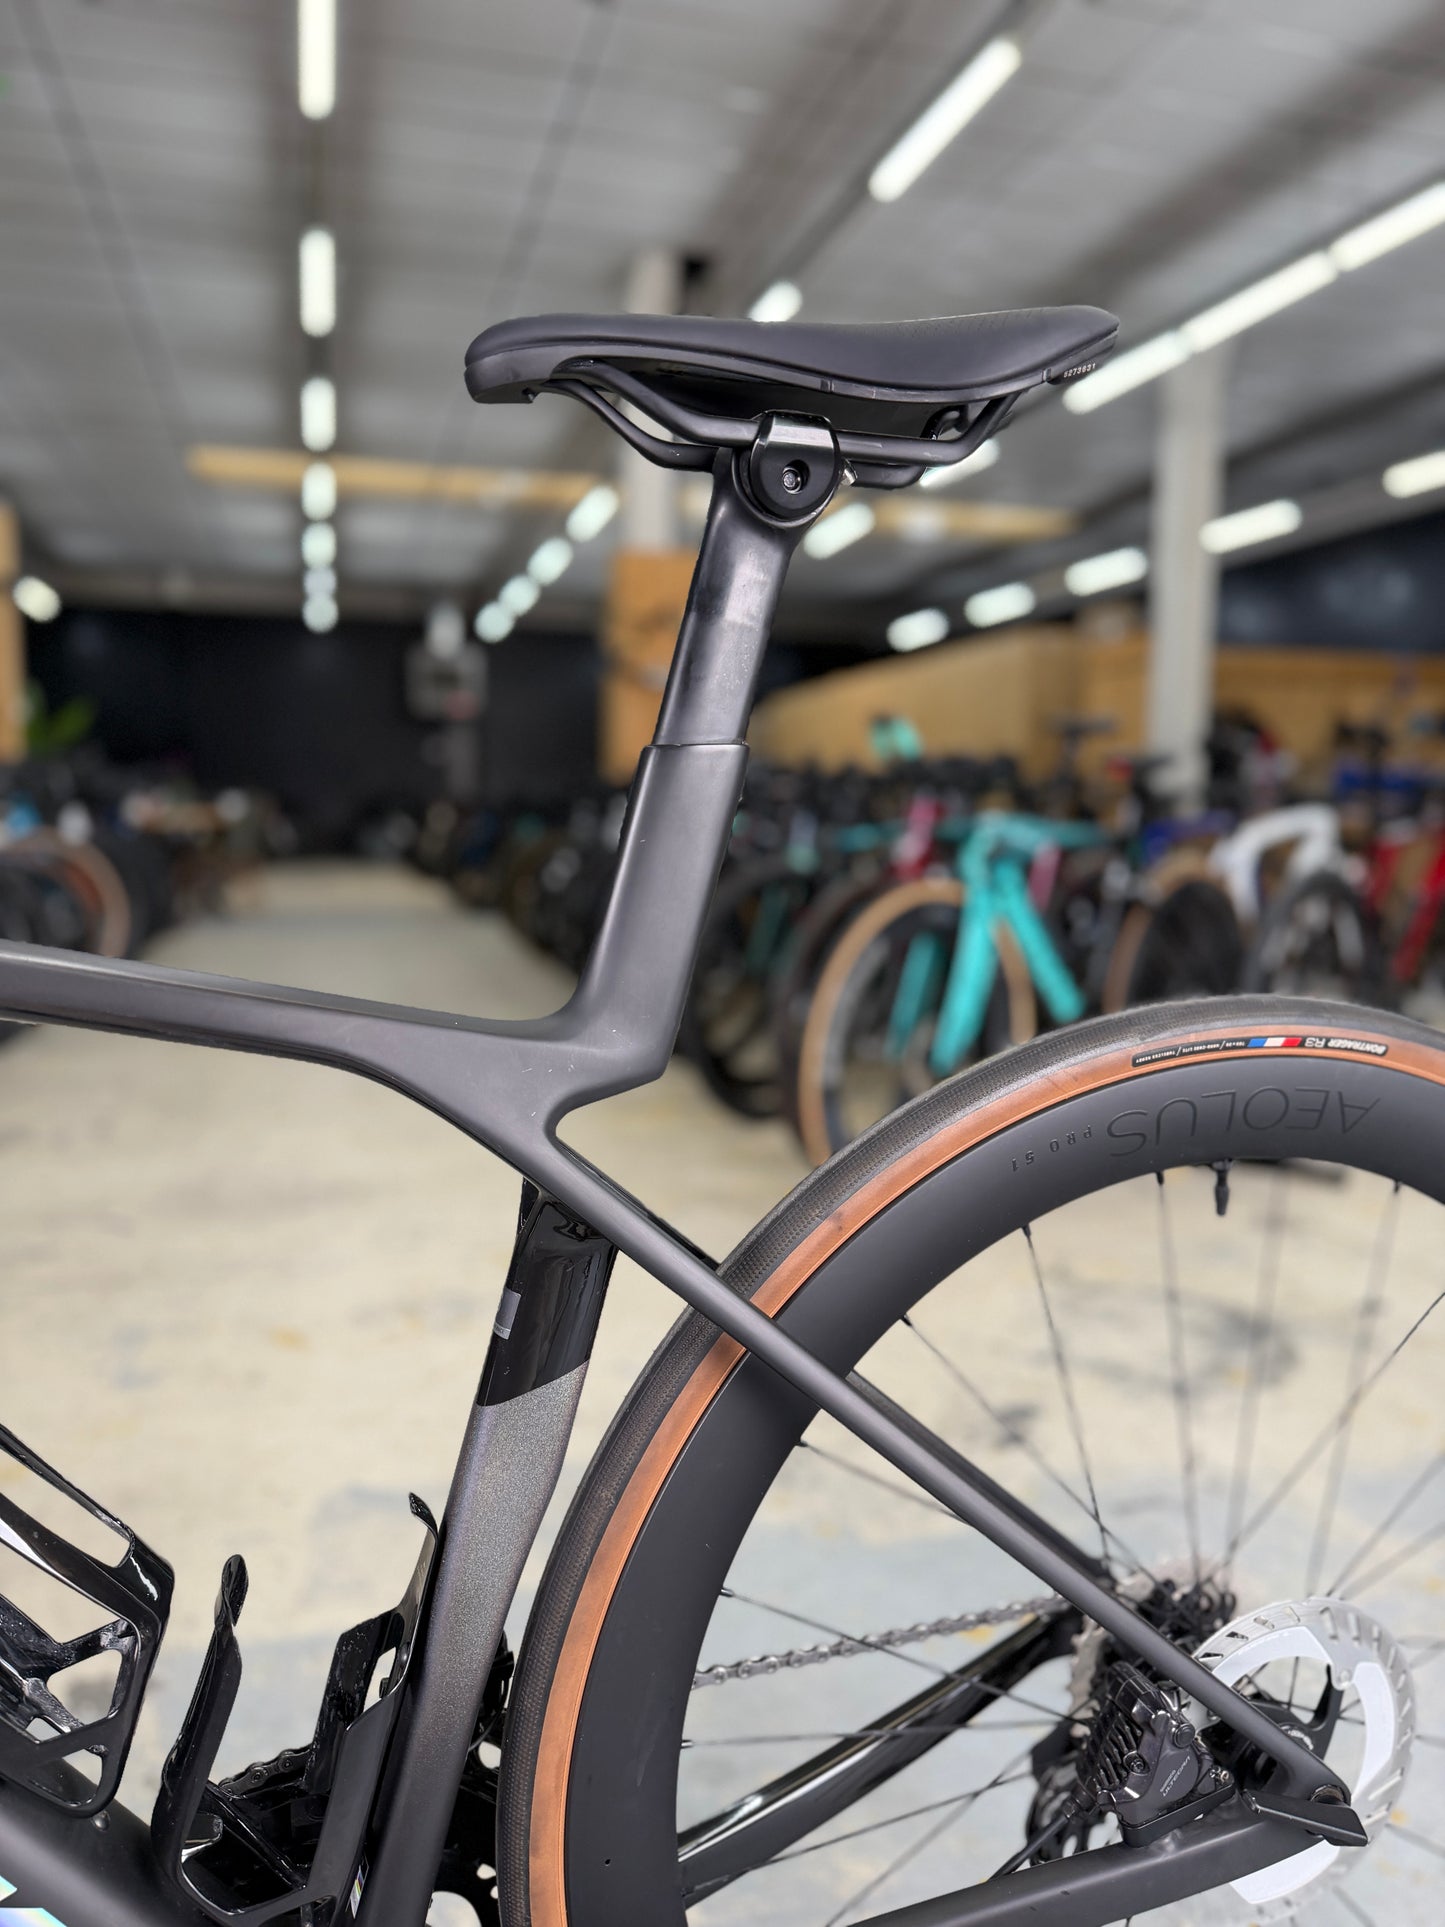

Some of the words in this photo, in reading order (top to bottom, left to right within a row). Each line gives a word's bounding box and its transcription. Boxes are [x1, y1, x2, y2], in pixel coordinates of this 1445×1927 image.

[1304, 1036, 1326, 1048] R3
[1326, 1038, 1387, 1055] BONTRAGER
[1106, 1085, 1381, 1158] AEOLUS
[1049, 1124, 1093, 1154] PRO
[1011, 1149, 1036, 1173] 51
